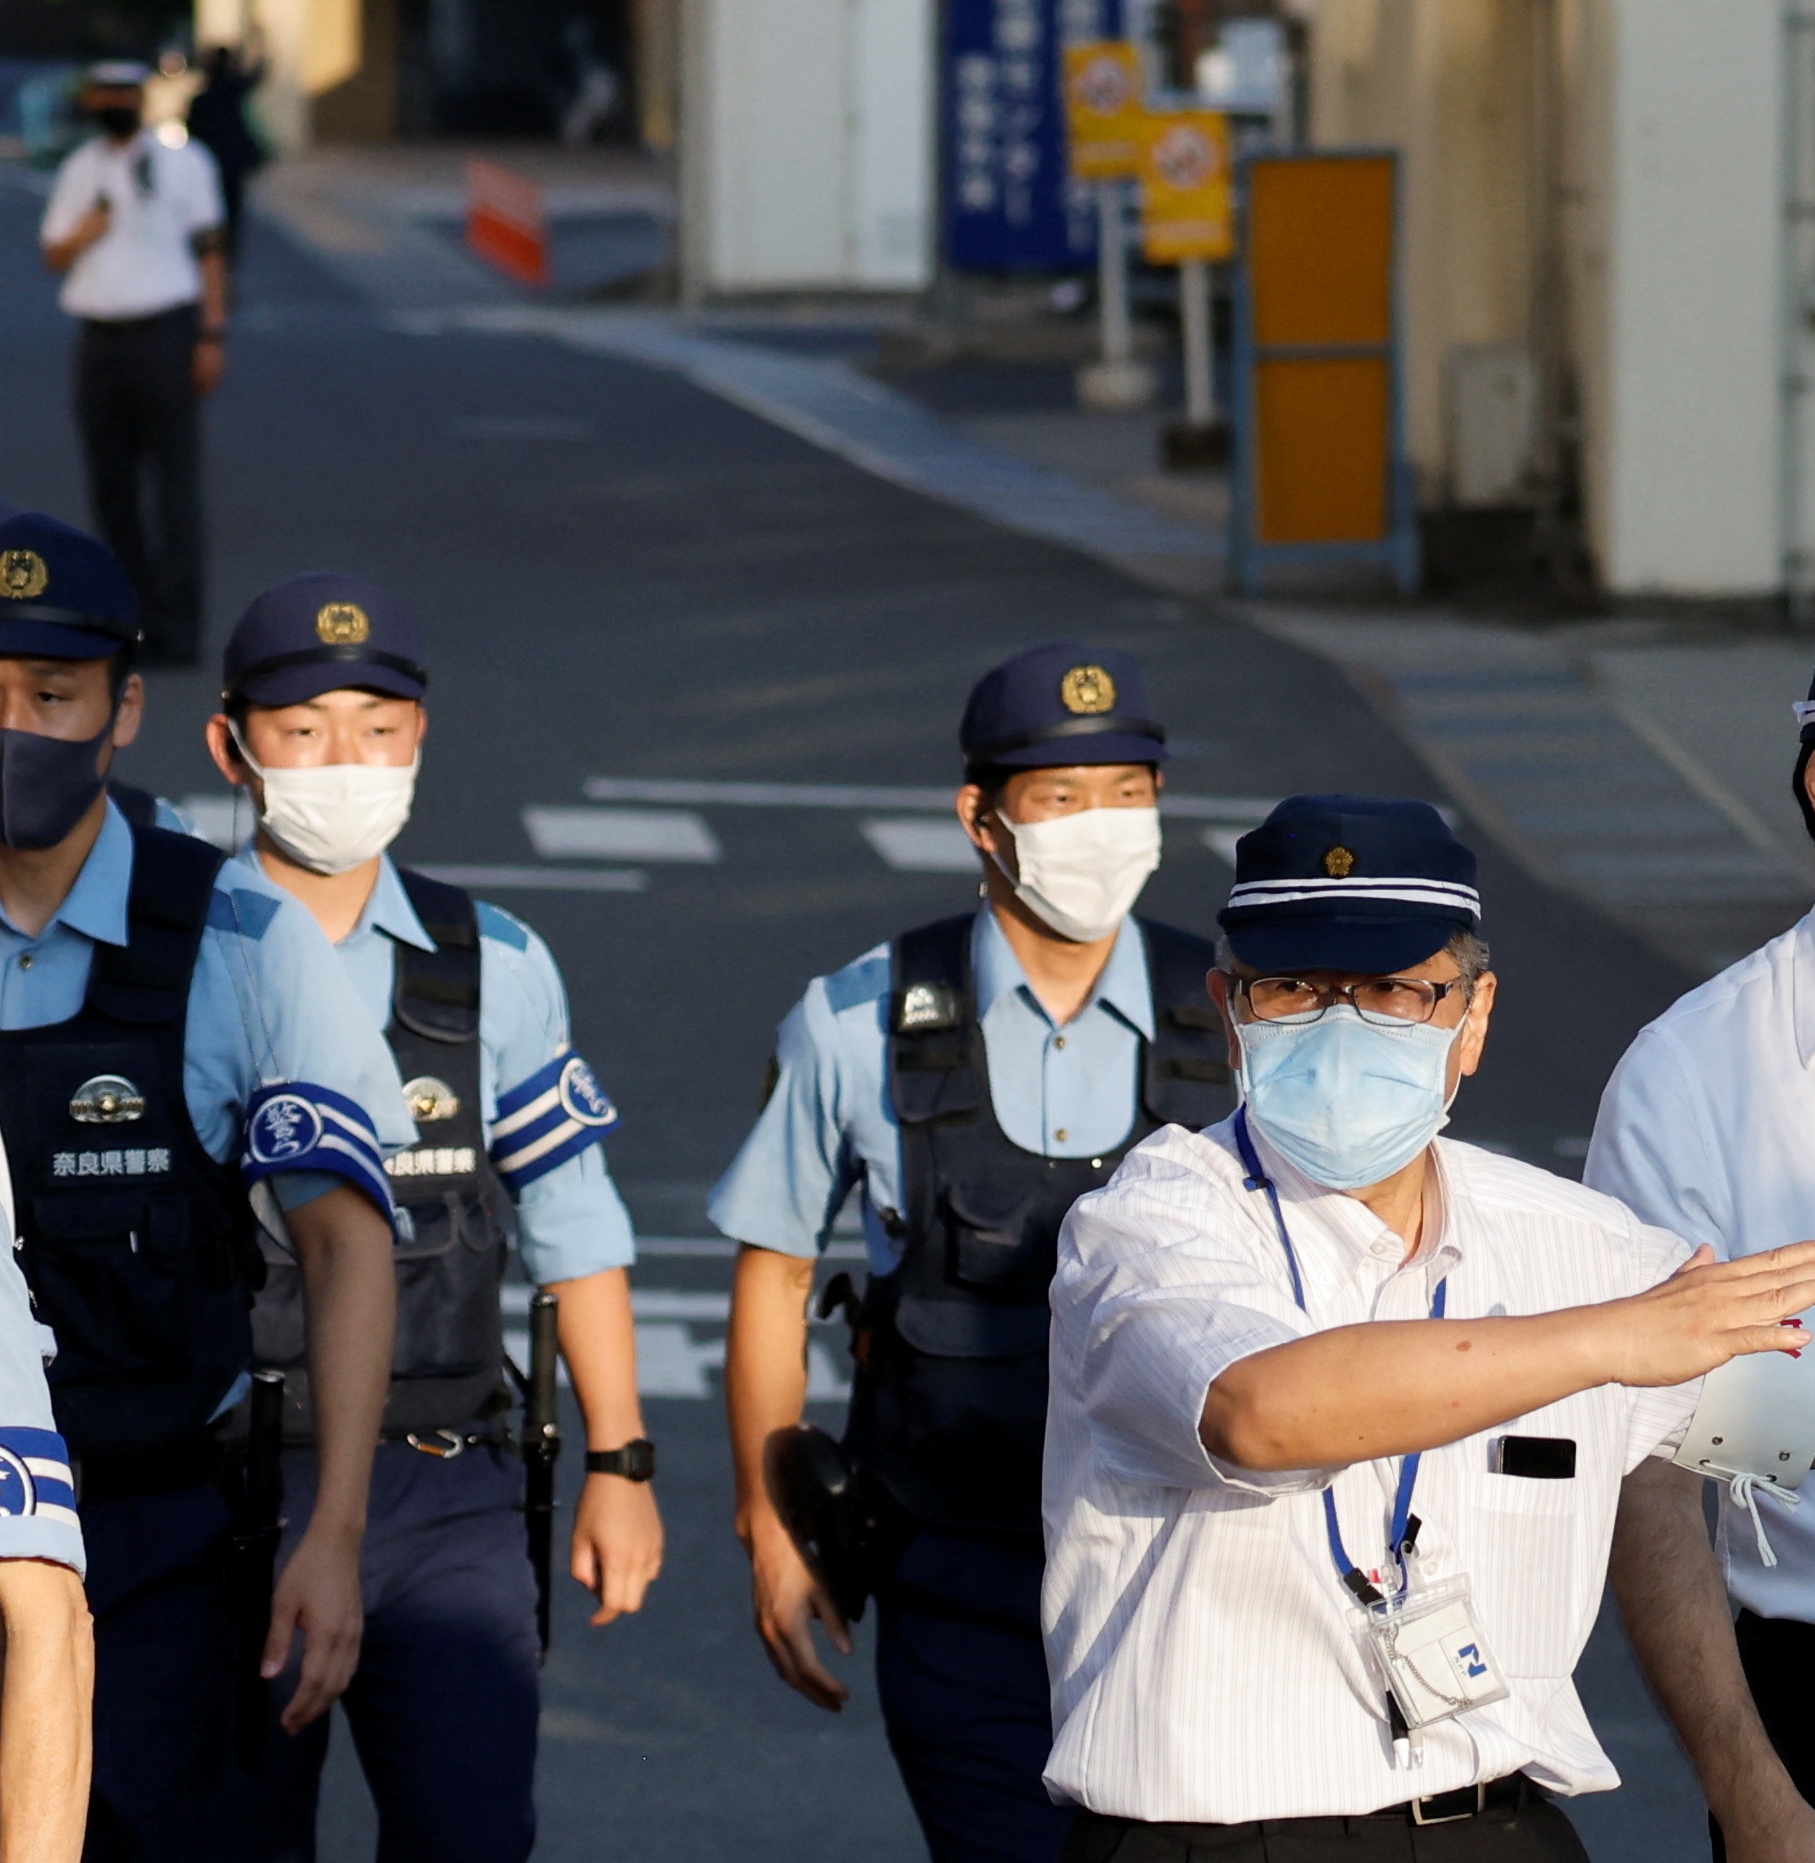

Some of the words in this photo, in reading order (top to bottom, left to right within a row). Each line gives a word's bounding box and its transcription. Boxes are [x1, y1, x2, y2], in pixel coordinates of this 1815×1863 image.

[52, 1148, 170, 1177] 奈良県警察
